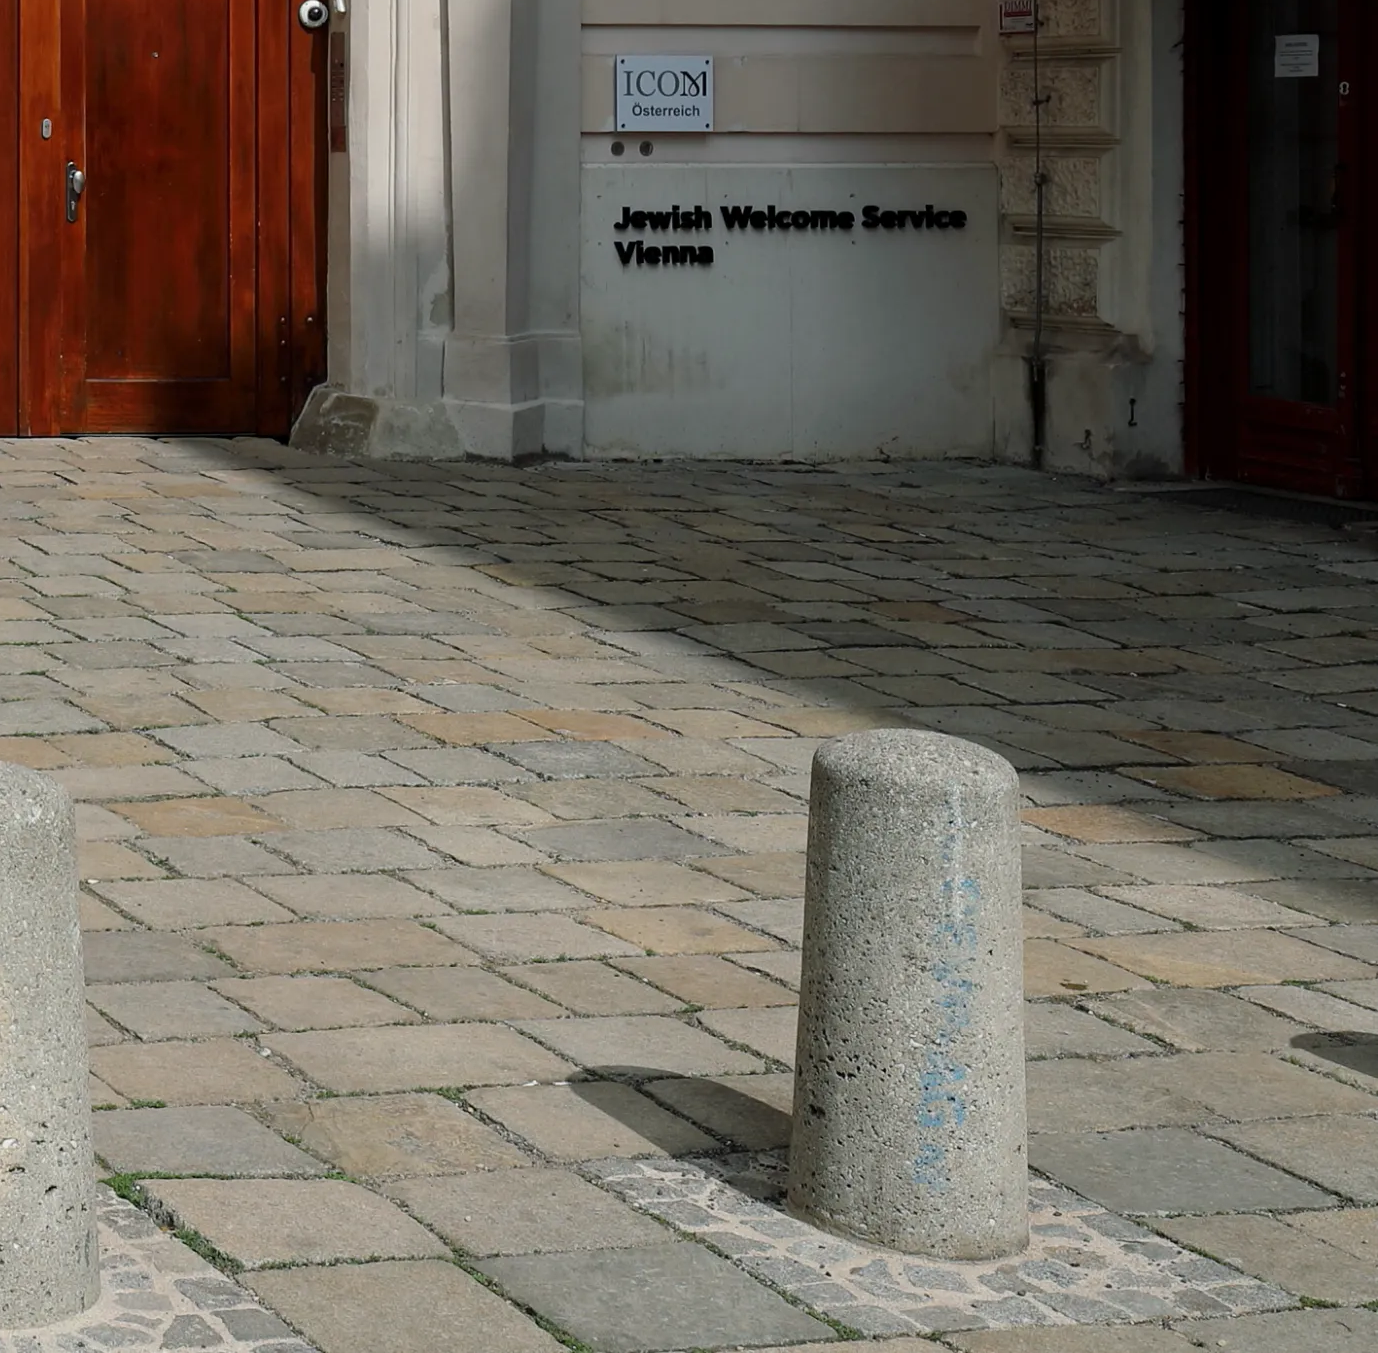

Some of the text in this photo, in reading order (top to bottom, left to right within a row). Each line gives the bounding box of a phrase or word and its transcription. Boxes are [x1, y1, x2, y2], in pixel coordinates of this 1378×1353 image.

[623, 70, 707, 97] ICOM
[632, 101, 700, 117] Österreich
[614, 204, 968, 230] Jewish Welcome Service
[614, 240, 714, 265] Vienna
